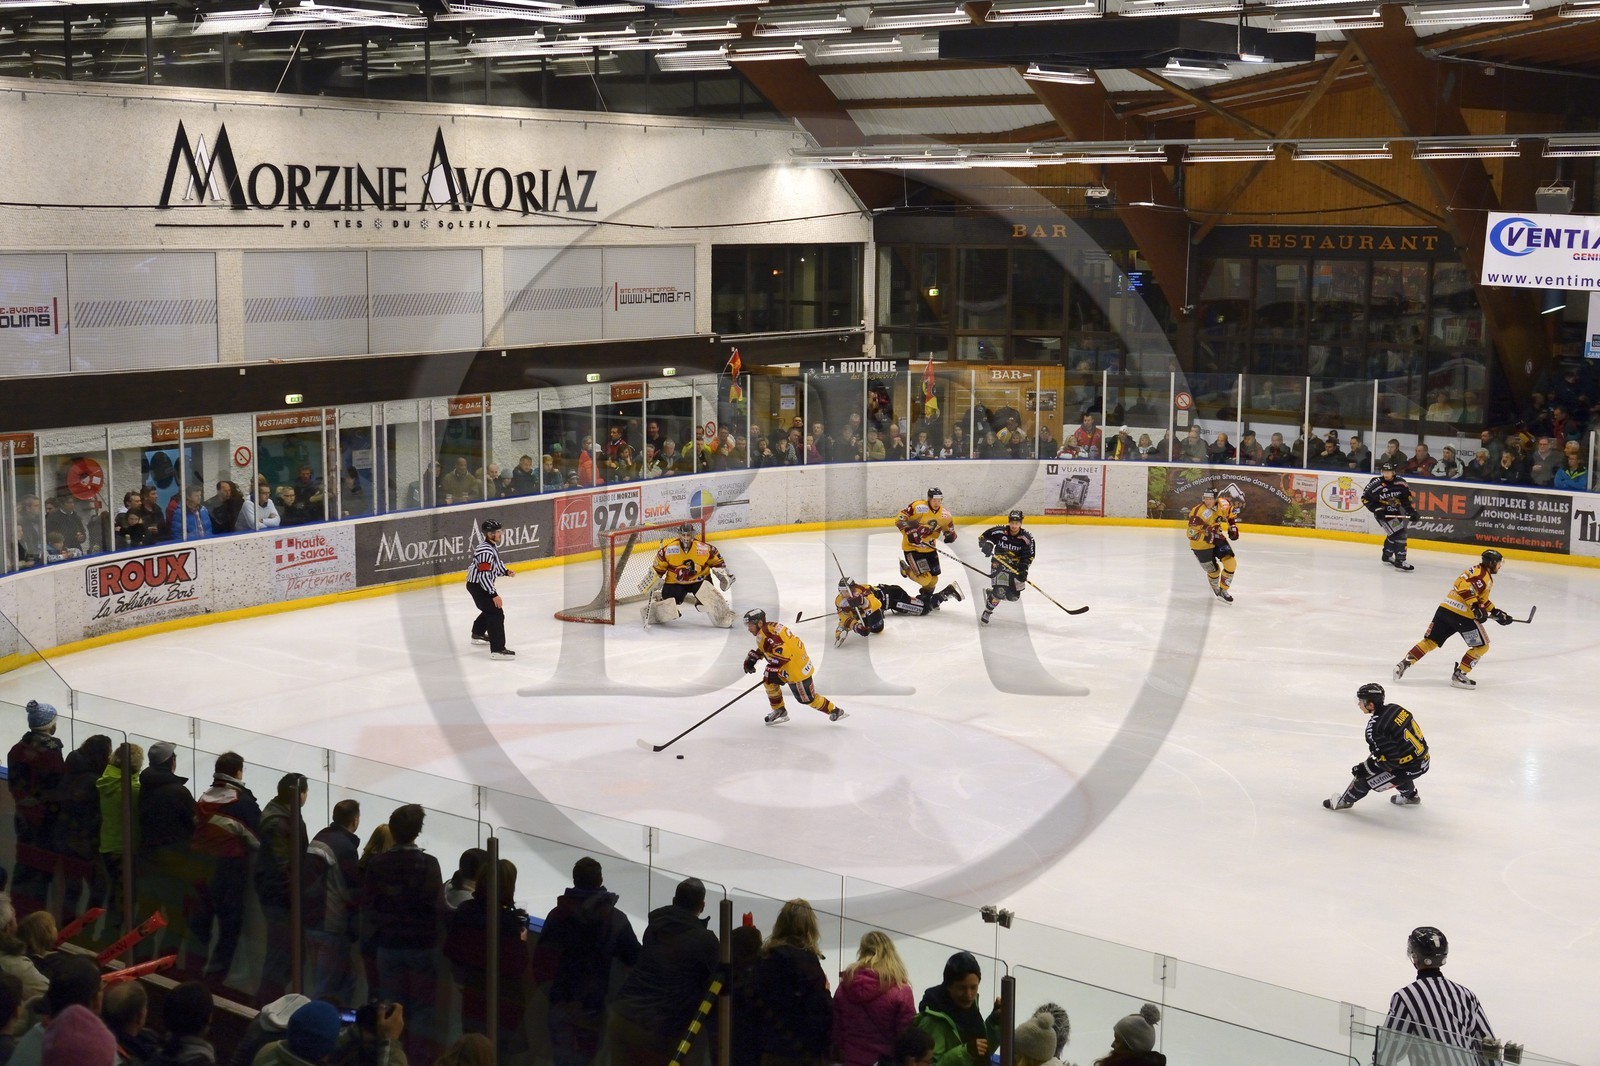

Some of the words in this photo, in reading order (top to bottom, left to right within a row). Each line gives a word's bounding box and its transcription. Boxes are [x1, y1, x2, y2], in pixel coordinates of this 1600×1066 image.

[155, 119, 407, 210] MORZINE
[418, 125, 598, 217] AVORIAZ
[392, 220, 410, 229] DU
[438, 220, 492, 230] SOLEIL
[1012, 224, 1068, 238] BAR
[1248, 233, 1439, 251] RESTAURANT
[1572, 252, 1600, 262] GENI
[840, 360, 897, 374] BOUTIQUE
[991, 369, 1021, 380] BAR
[465, 400, 491, 410] DAMS
[259, 416, 299, 428] VESTIAIRES
[1061, 466, 1099, 474] VUARNET
[1173, 483, 1193, 495] Viens
[1192, 474, 1222, 487] rejoindre
[1252, 479, 1270, 490] dans
[616, 490, 639, 501] MORZINE
[1473, 495, 1527, 510] MULTIPLEXE
[1529, 500, 1535, 510] 8
[1537, 500, 1570, 513] SALLES
[560, 510, 588, 531] RTL2
[1474, 520, 1494, 529] Sortie
[1506, 523, 1515, 531] du
[1574, 509, 1600, 543] Ti
[295, 534, 326, 550] haute
[374, 530, 464, 566] MORZINE
[467, 517, 540, 553] ARIAZ
[1475, 532, 1565, 549] www.cineleman.fr
[300, 546, 335, 560] savoie
[99, 551, 193, 598] ROUX
